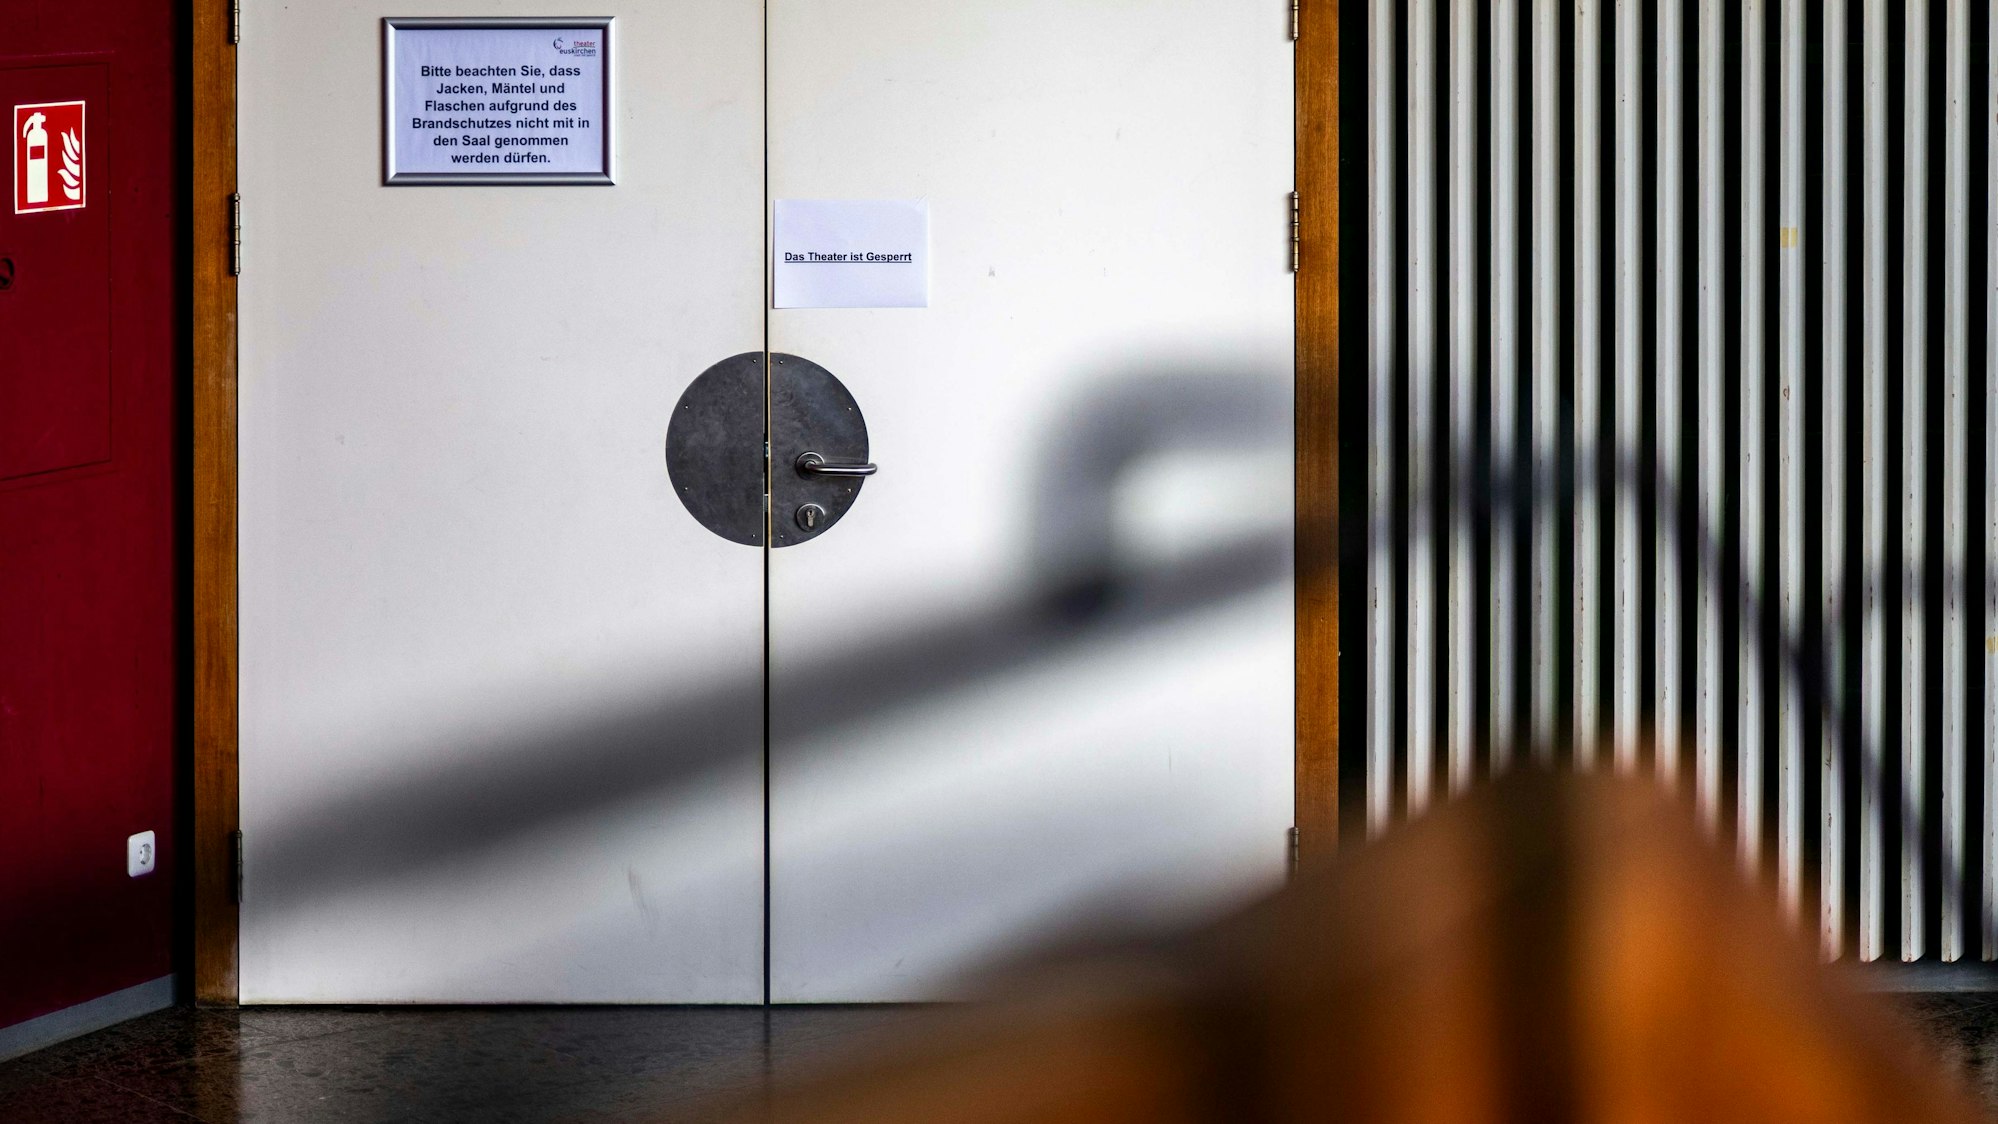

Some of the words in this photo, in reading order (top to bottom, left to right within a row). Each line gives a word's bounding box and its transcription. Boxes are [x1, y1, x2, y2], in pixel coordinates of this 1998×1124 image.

[421, 65, 451, 77] Bitte
[456, 65, 516, 77] beachten
[520, 65, 545, 78] Sie,
[549, 65, 581, 77] dass
[436, 82, 487, 95] Jacken,
[492, 82, 536, 94] Mäntel
[540, 82, 565, 94] und
[425, 100, 485, 111] Flaschen
[489, 100, 549, 114] aufgrund
[553, 100, 577, 111] des
[412, 117, 511, 129] Brandschutzes
[516, 117, 549, 129] nicht
[553, 117, 574, 129] mit
[578, 117, 590, 129] in
[433, 134, 458, 146] den
[462, 134, 490, 146] Saal
[494, 137, 569, 149] genommen
[451, 152, 500, 163] werden
[504, 152, 551, 163] dürfen.
[784, 251, 805, 261] Das
[808, 251, 848, 261] Theater
[850, 251, 863, 261] ist
[866, 251, 912, 262] Gesperrt
